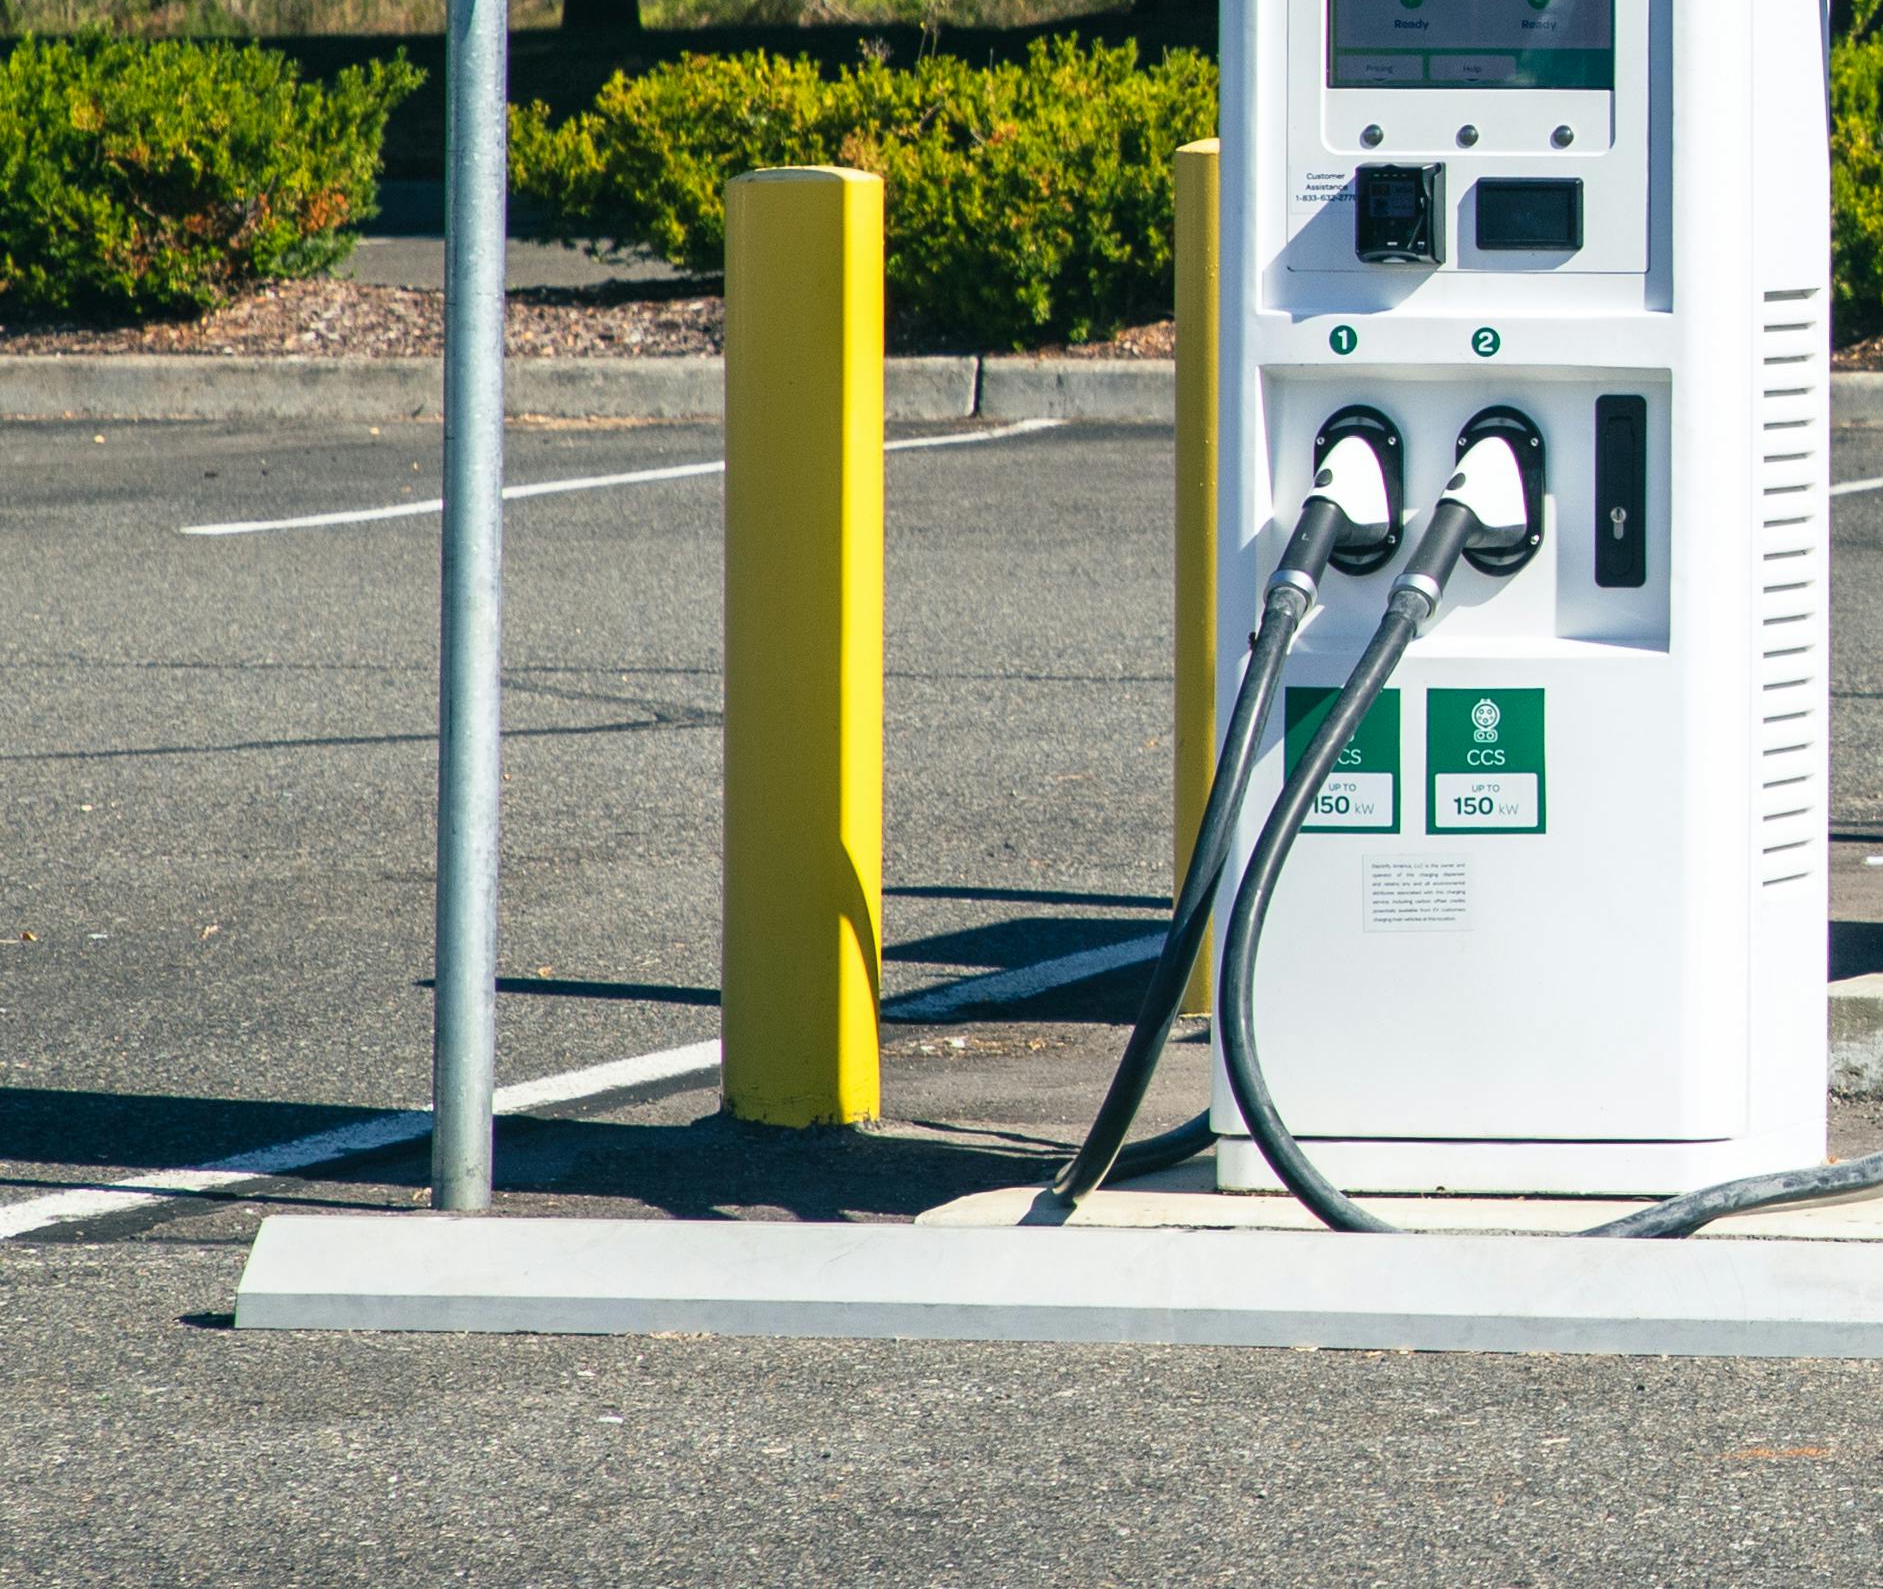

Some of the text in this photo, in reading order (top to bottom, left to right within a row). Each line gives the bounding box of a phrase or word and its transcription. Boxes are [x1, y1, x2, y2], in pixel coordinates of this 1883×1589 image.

[1394, 19, 1430, 31] Ready
[1520, 19, 1558, 31] Ready
[1306, 183, 1348, 191] Assistance
[1338, 329, 1348, 351] 1
[1478, 331, 1494, 353] 2
[1336, 749, 1362, 765] CS
[1466, 749, 1506, 765] CCS
[1328, 783, 1356, 792] UP TO
[1471, 784, 1500, 793] UP TO
[1354, 803, 1374, 815] kW
[1452, 797, 1520, 815] 150 kW
